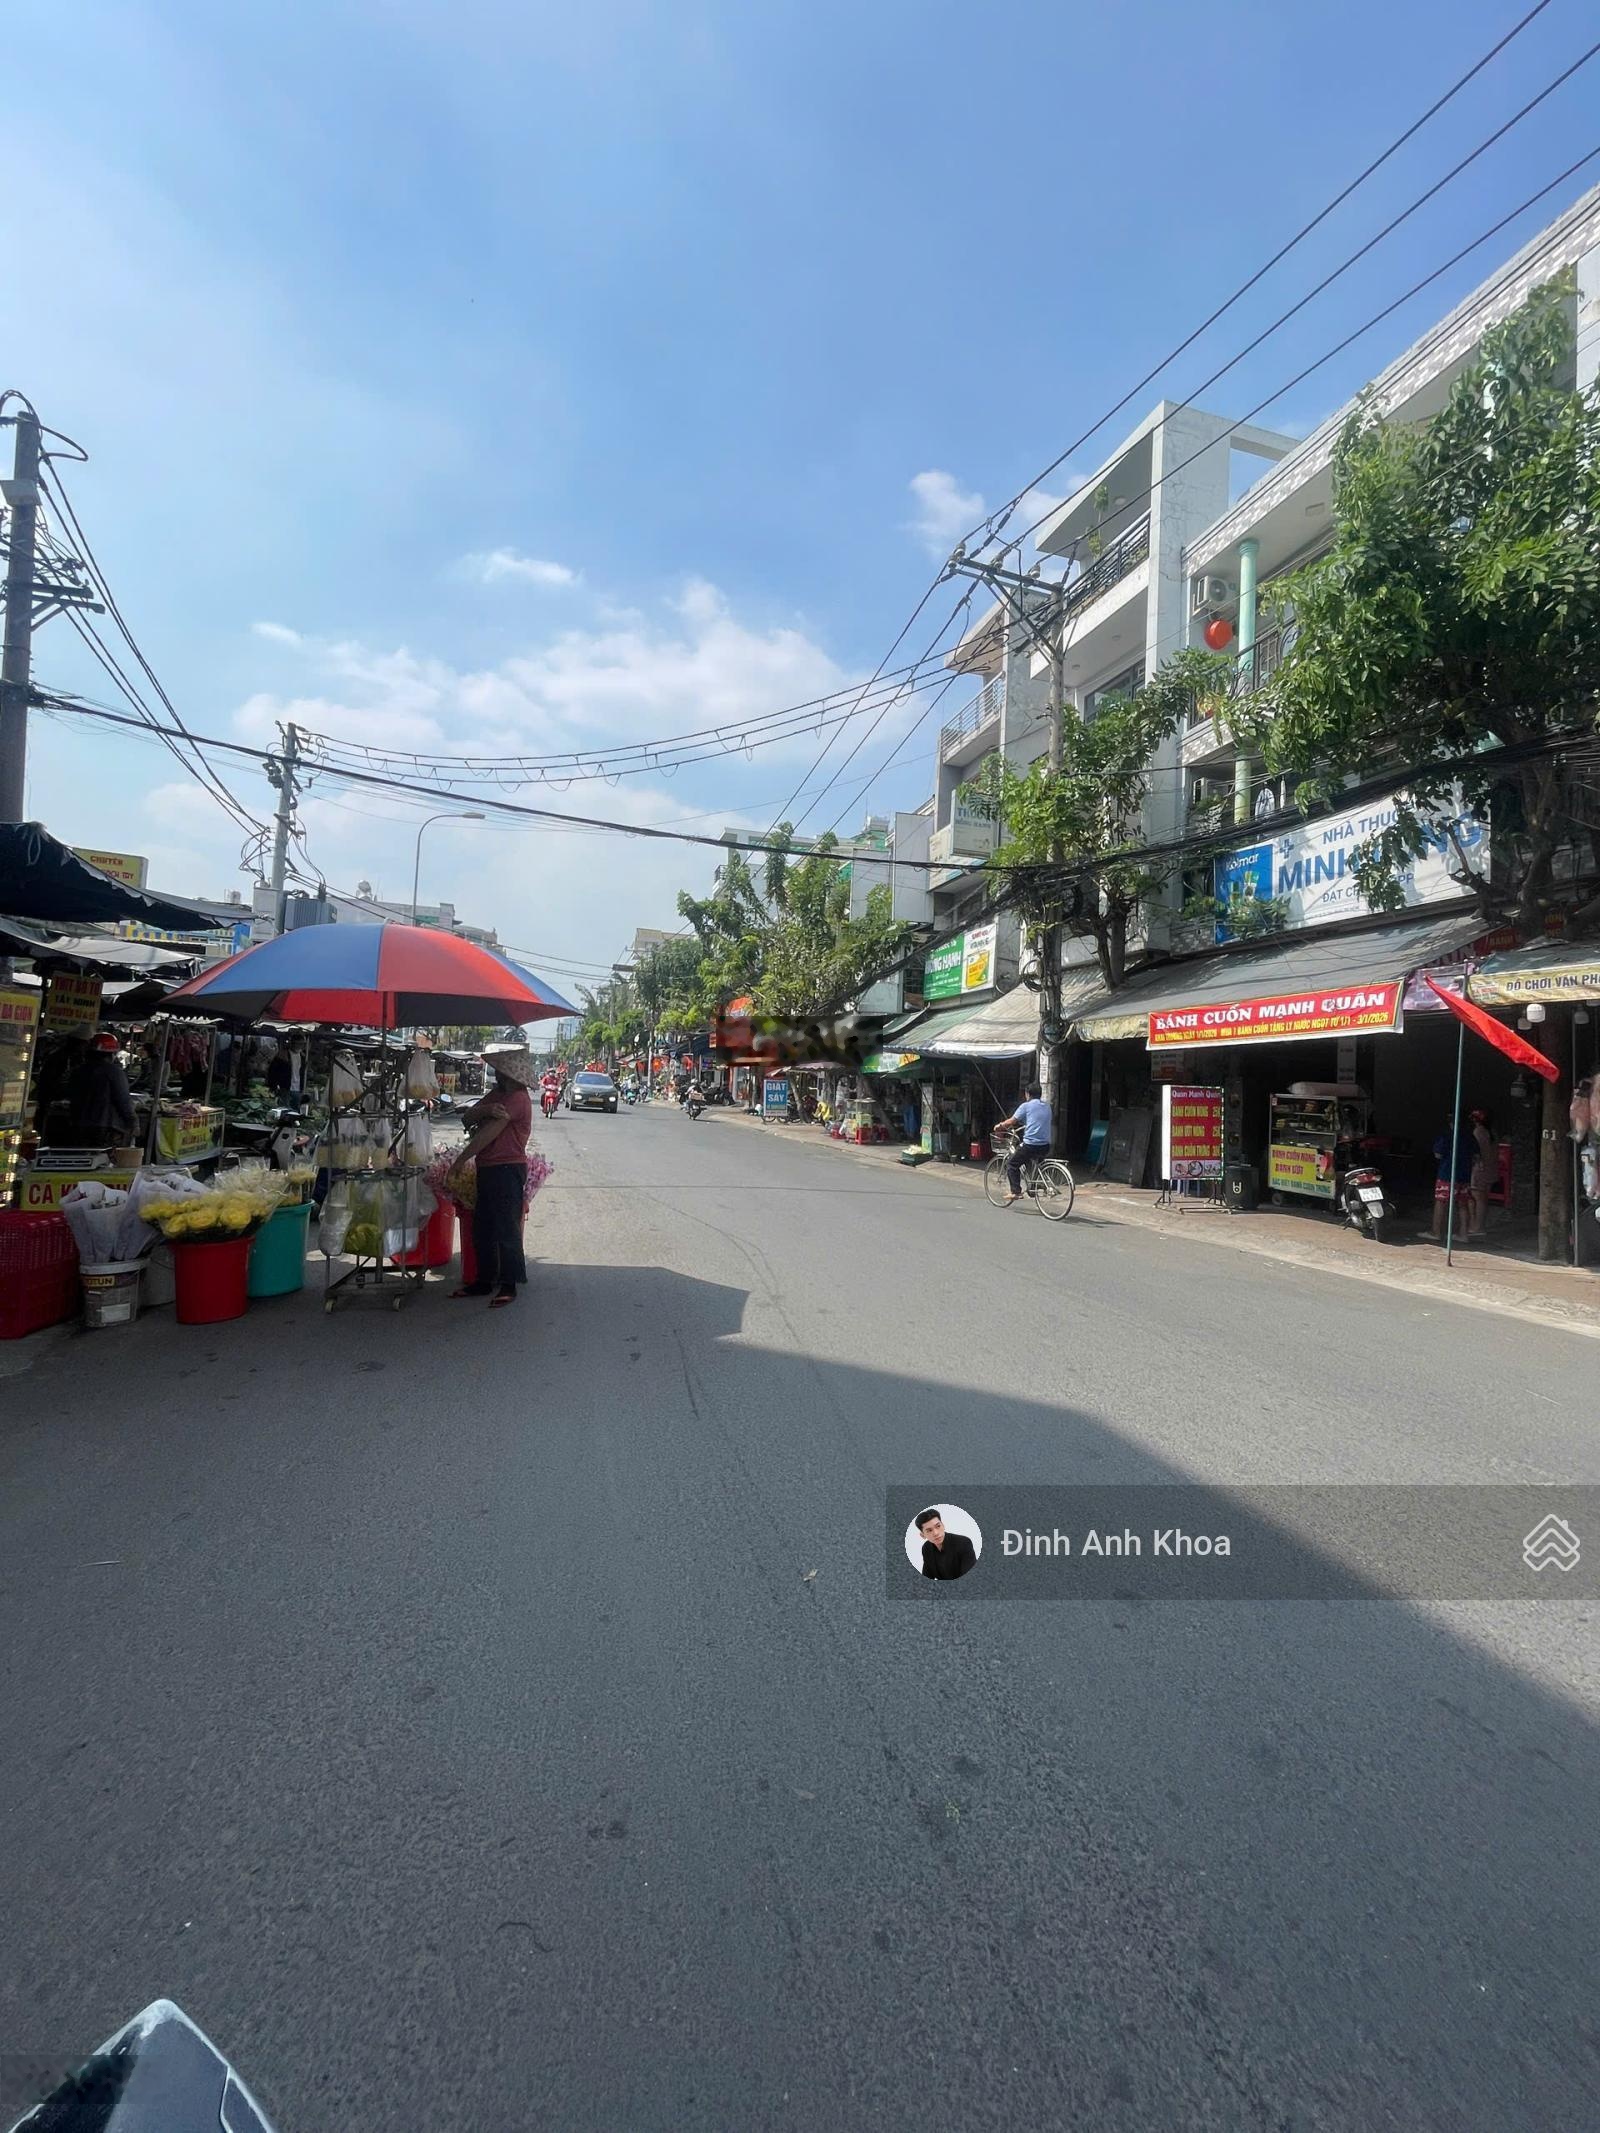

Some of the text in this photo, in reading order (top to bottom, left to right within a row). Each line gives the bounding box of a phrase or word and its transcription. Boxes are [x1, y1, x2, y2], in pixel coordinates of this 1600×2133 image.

[1323, 820, 1354, 844] NHÀ
[1525, 977, 1551, 990] CHƠI
[1155, 992, 1386, 1029] BÁNH CUỐN MẠNH QUÂN
